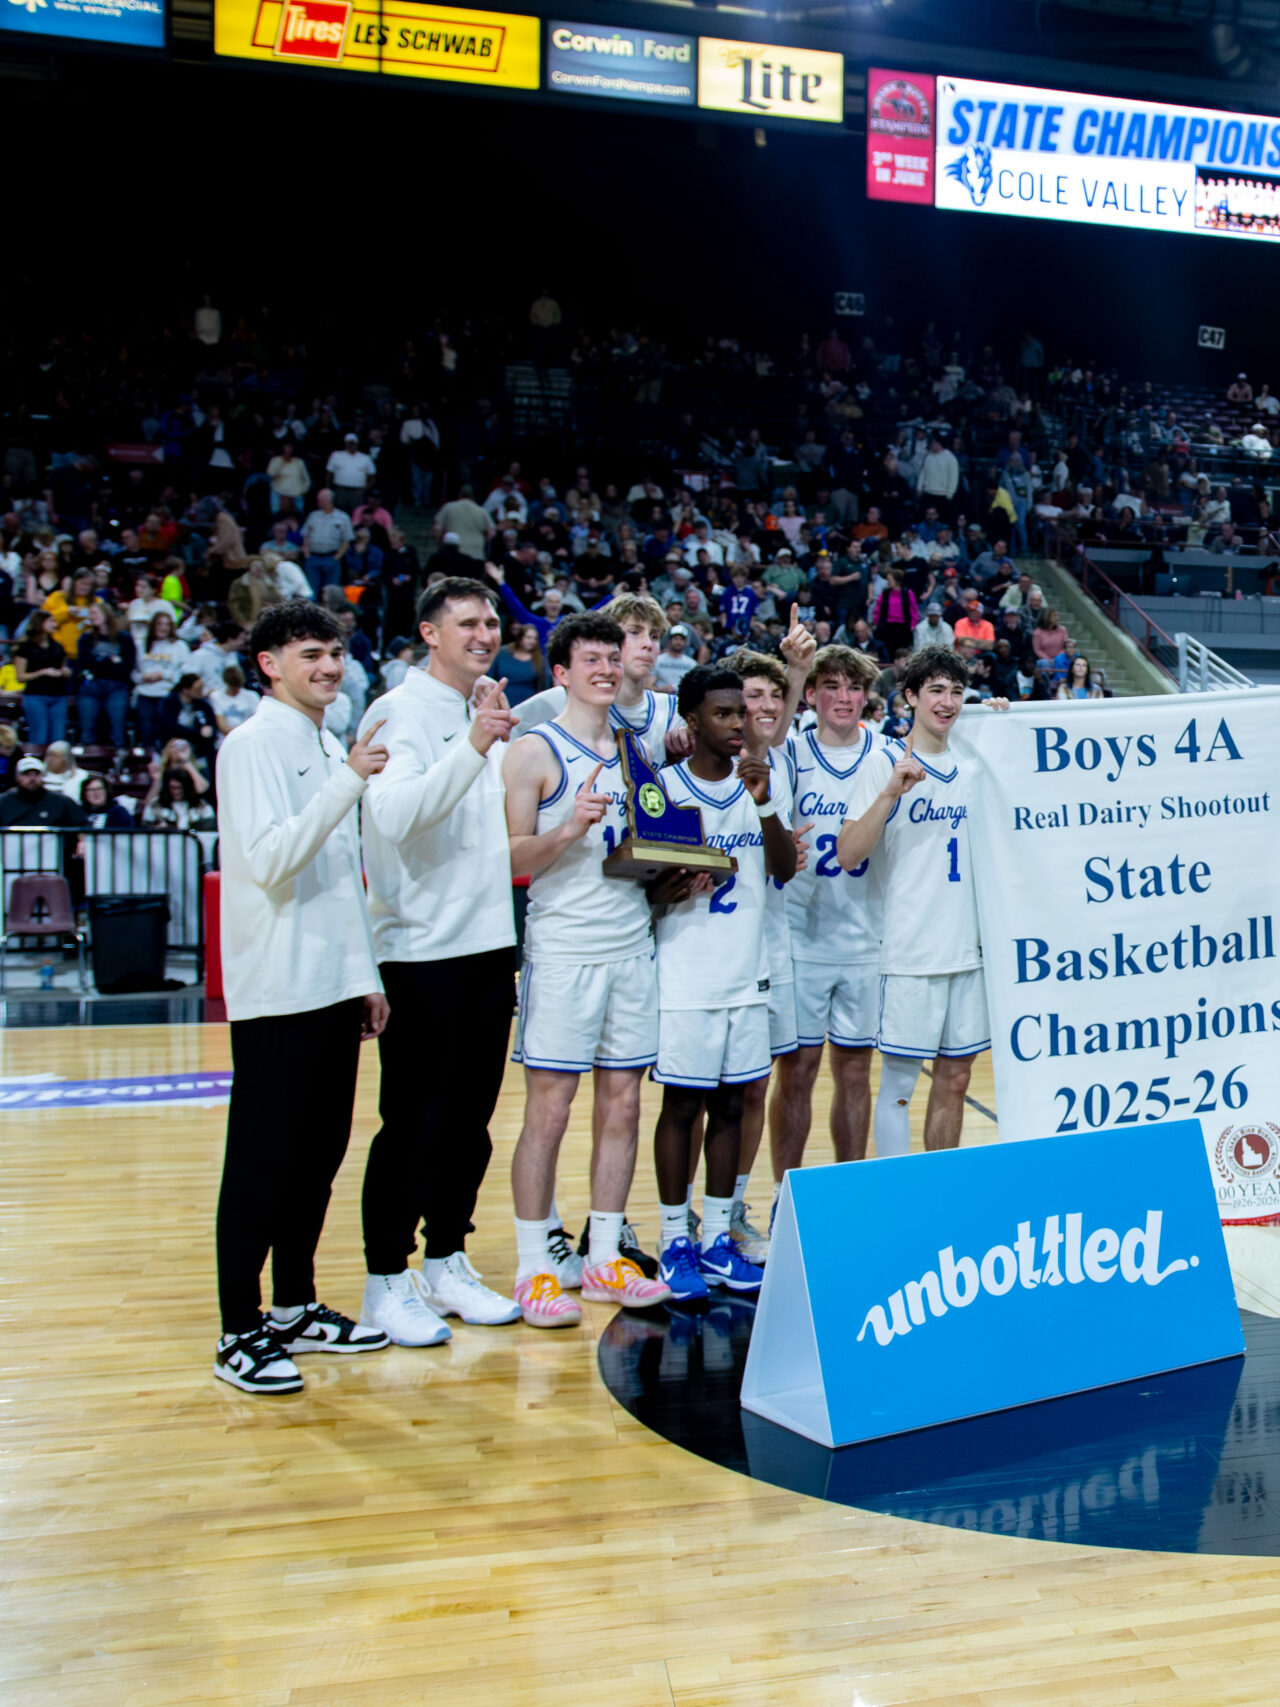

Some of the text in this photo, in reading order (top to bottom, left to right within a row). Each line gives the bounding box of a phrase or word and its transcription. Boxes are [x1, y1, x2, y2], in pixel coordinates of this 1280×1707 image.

[286, 5, 343, 43] Tires
[354, 22, 493, 57] LES SCHWAB
[552, 28, 690, 63] Corwin Ford
[739, 56, 823, 110] Lite
[948, 98, 1064, 153] STATE
[998, 169, 1189, 217] COLE VALLEY
[730, 596, 750, 614] 17
[1031, 716, 1244, 783] Boys 4A
[1012, 791, 1270, 832] Real Dairy Shootout
[705, 830, 764, 857] argers
[947, 837, 961, 882] 1
[1084, 854, 1212, 905] State
[1013, 915, 1277, 985] Basketball
[1053, 1063, 1250, 1133] 2025-26
[1218, 1184, 1237, 1201] 00
[1232, 1196, 1280, 1209] 1926-2026
